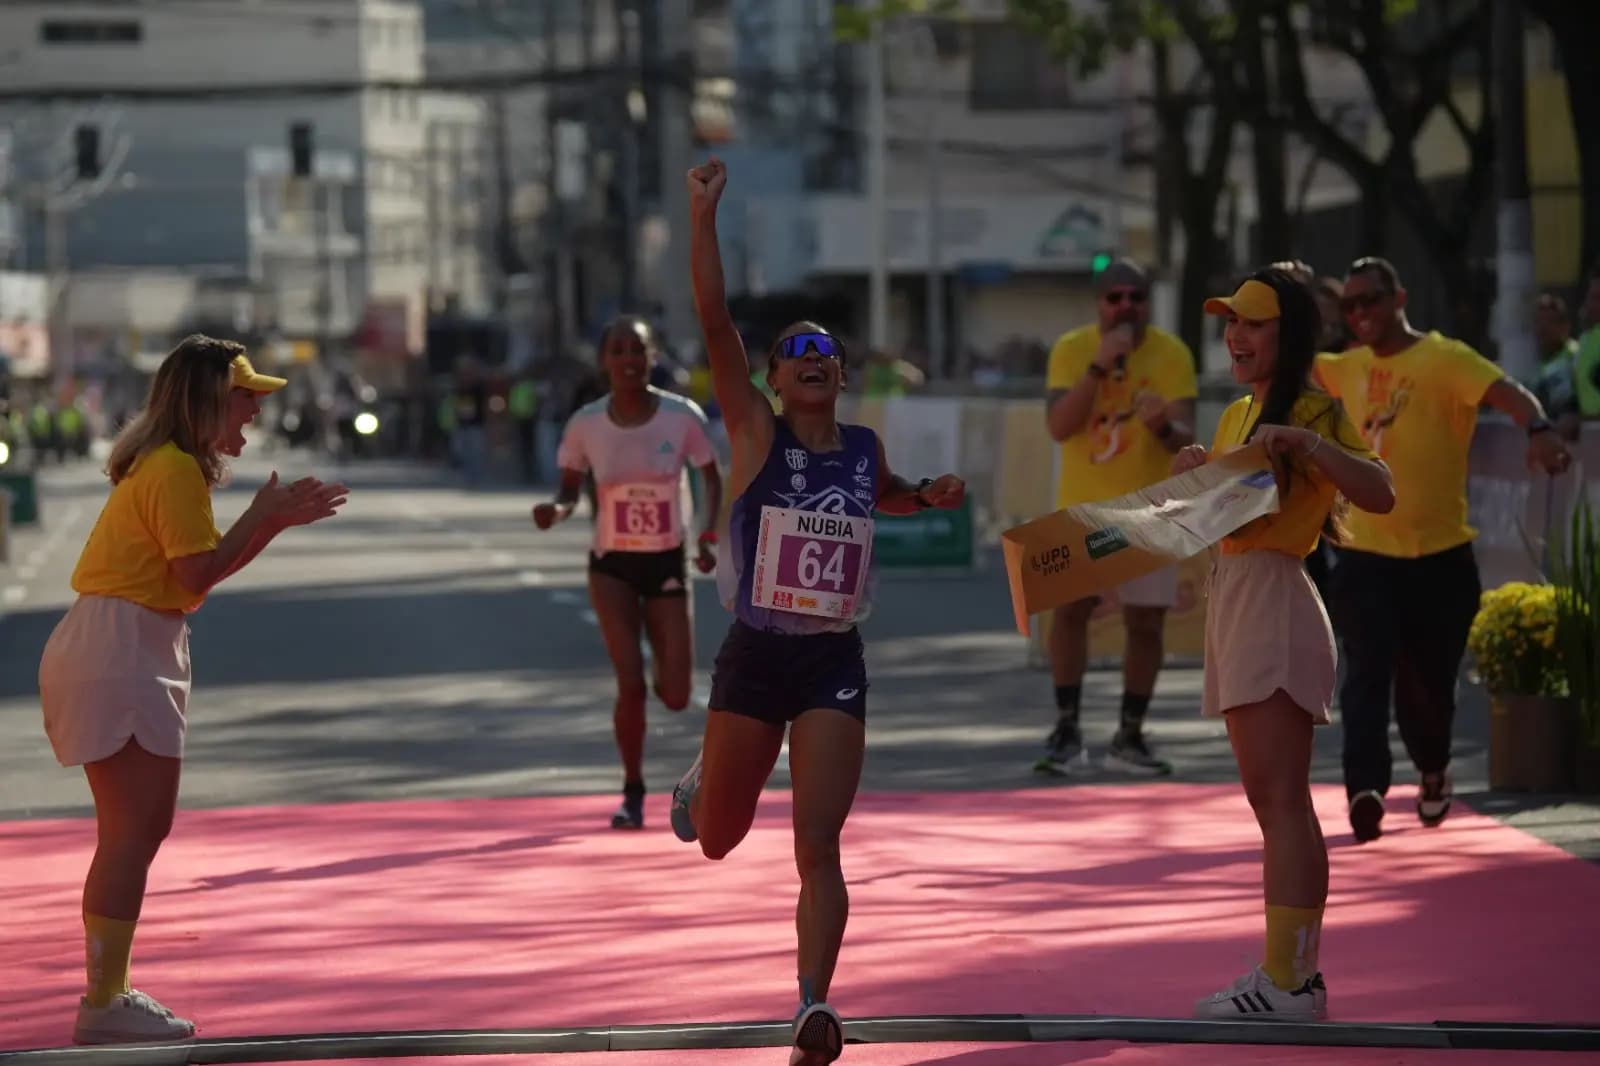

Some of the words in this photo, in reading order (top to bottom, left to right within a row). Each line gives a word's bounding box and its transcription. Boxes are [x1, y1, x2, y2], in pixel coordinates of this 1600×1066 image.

[626, 501, 661, 535] 63
[798, 515, 854, 538] NÚBIA
[797, 540, 846, 591] 64
